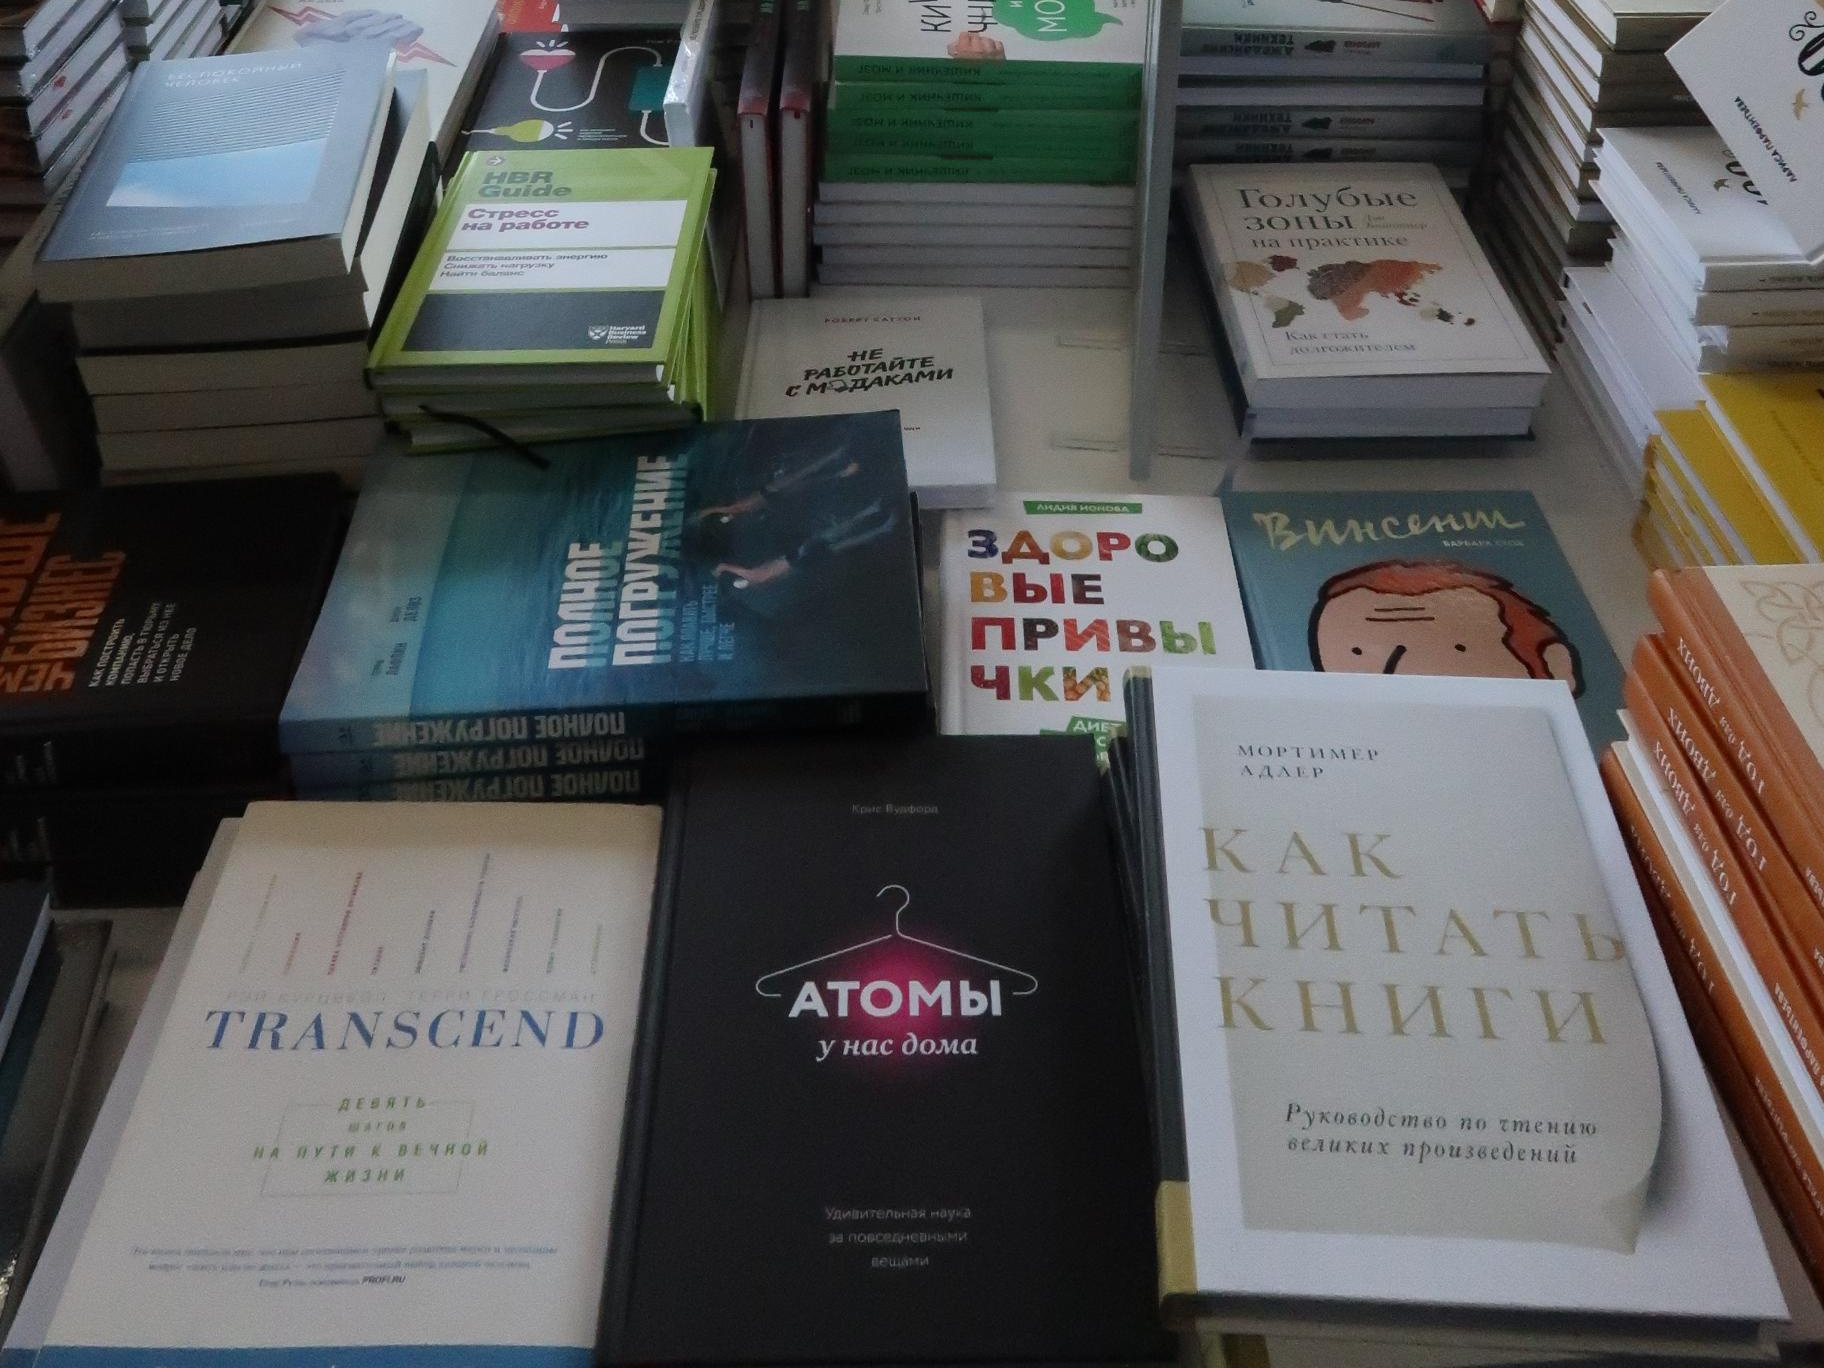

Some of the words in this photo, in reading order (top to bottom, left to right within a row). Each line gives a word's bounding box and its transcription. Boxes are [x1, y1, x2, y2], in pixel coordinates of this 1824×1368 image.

[477, 184, 572, 198] Guide
[482, 171, 554, 185] HBR
[1235, 186, 1418, 212] Голубые
[461, 221, 493, 231] на
[498, 218, 590, 233] работе
[468, 207, 560, 224] Стресс
[1245, 215, 1354, 232] зоны
[1250, 236, 1281, 249] на
[1290, 235, 1410, 253] практике
[1284, 331, 1319, 341] Как
[803, 356, 936, 382] РАБОТАЙТЕ
[847, 348, 884, 362] НЕ
[1035, 502, 1078, 514] ЛИДИЯ
[1079, 503, 1132, 515] ИОНОВА
[1252, 510, 1525, 551] Винсент
[612, 454, 690, 669] ПОГРУЖЕНИЕ
[967, 529, 1179, 565] ЗДОРО
[969, 571, 1105, 605] ВЫЕ
[1, 551, 127, 664] БИЗНЕС
[548, 541, 624, 670] ПОЛНОЕ
[970, 617, 1217, 655] ПРИВЫ
[970, 665, 1112, 702] ЧКИ
[1676, 635, 1722, 709] ДВОИХ
[372, 715, 529, 749] ПОГРУЖЕНИЕ
[533, 711, 626, 739] ПОЛНОЕ
[555, 737, 645, 766] ПОЛНОЕ
[1237, 743, 1379, 761] МОРТИМЕР
[1665, 706, 1719, 784] ДВОИХ
[1239, 765, 1324, 780] АДЛЕР
[1654, 740, 1697, 817] ДВОИХ
[1737, 738, 1767, 796] ГОД
[548, 770, 642, 799] ПОЛНОЕ
[1199, 826, 1402, 881] КАК
[1736, 814, 1769, 874] ГОД
[1711, 847, 1739, 909] ГОД
[1201, 896, 1627, 963] ЧИТАТЬ
[788, 978, 1003, 1019] АТОМЫ
[1212, 973, 1608, 1044] КНИГИ
[205, 1008, 604, 1051] TRANSCEND
[815, 1034, 836, 1063] у
[842, 1035, 895, 1057] нас
[900, 1030, 979, 1058] дома
[337, 1096, 429, 1113] ДЕВЯТЬ
[1285, 1102, 1449, 1133] Руководство
[1459, 1115, 1488, 1133] по
[1499, 1114, 1597, 1138] чтению
[253, 1145, 281, 1160] НА
[296, 1144, 357, 1160] ПУТИ
[398, 1138, 489, 1159] ВЕЧНОЙ
[1287, 1136, 1390, 1157] великих
[1400, 1136, 1578, 1165] произведений
[323, 1169, 407, 1185] ЖИЗНИ
[824, 1204, 927, 1226] Удивительная
[930, 1206, 973, 1222] наука
[828, 1231, 845, 1243] за
[848, 1228, 969, 1246] повседневными
[870, 1253, 931, 1272] вещами
